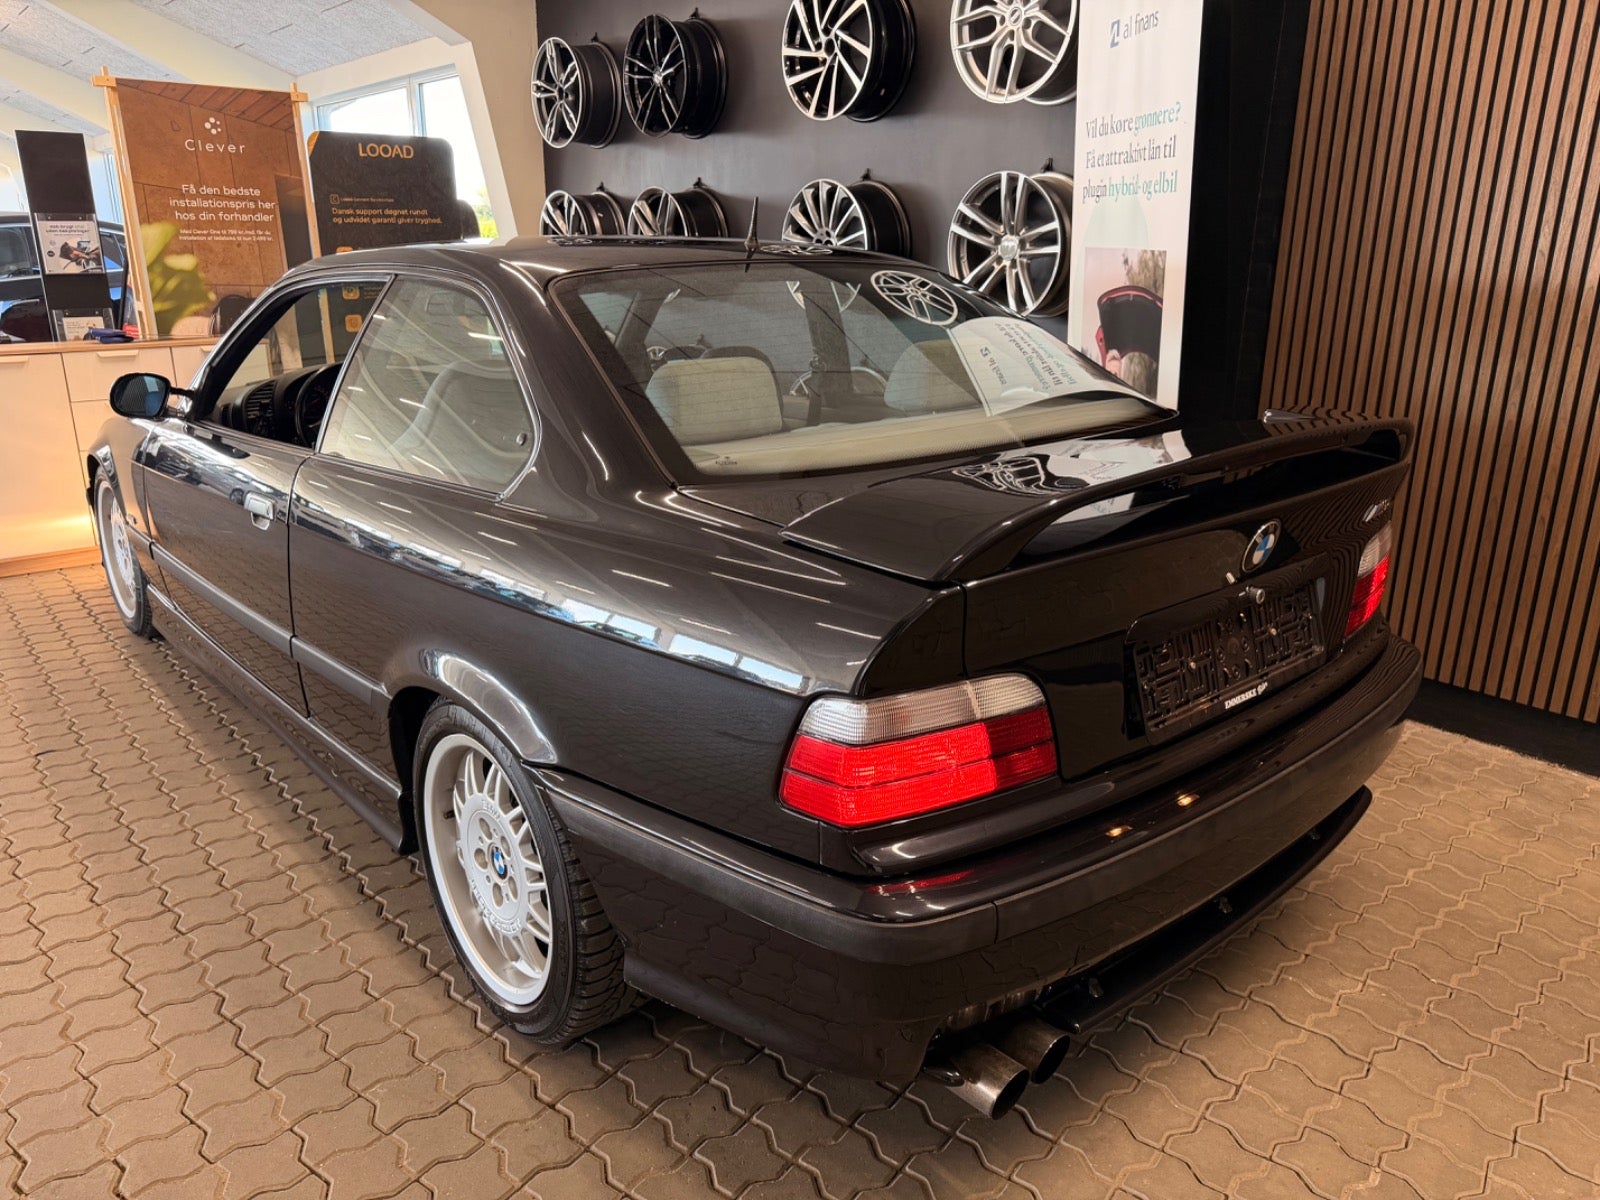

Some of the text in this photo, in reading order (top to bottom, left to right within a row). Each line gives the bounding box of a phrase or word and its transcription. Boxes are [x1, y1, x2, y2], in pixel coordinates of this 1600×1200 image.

[1135, 10, 1159, 36] finans
[1086, 117, 1098, 139] Vil
[1098, 116, 1109, 137] du
[184, 138, 246, 154] Clever
[358, 142, 415, 159] LOOAD
[1086, 134, 1177, 169] Få et attraktivt lån til
[181, 184, 261, 197] Få den bedste
[1082, 179, 1107, 204] plugin
[1142, 180, 1153, 201] og
[1153, 170, 1178, 195] elbil
[169, 196, 276, 211] installationspris her
[331, 207, 354, 216] Dansk
[355, 208, 383, 216] support
[409, 208, 429, 216] rundt
[175, 210, 274, 222] hos din forhandler
[332, 216, 343, 225] og
[343, 216, 371, 224] udvidet
[371, 216, 397, 225] garanti
[397, 217, 414, 225] giver
